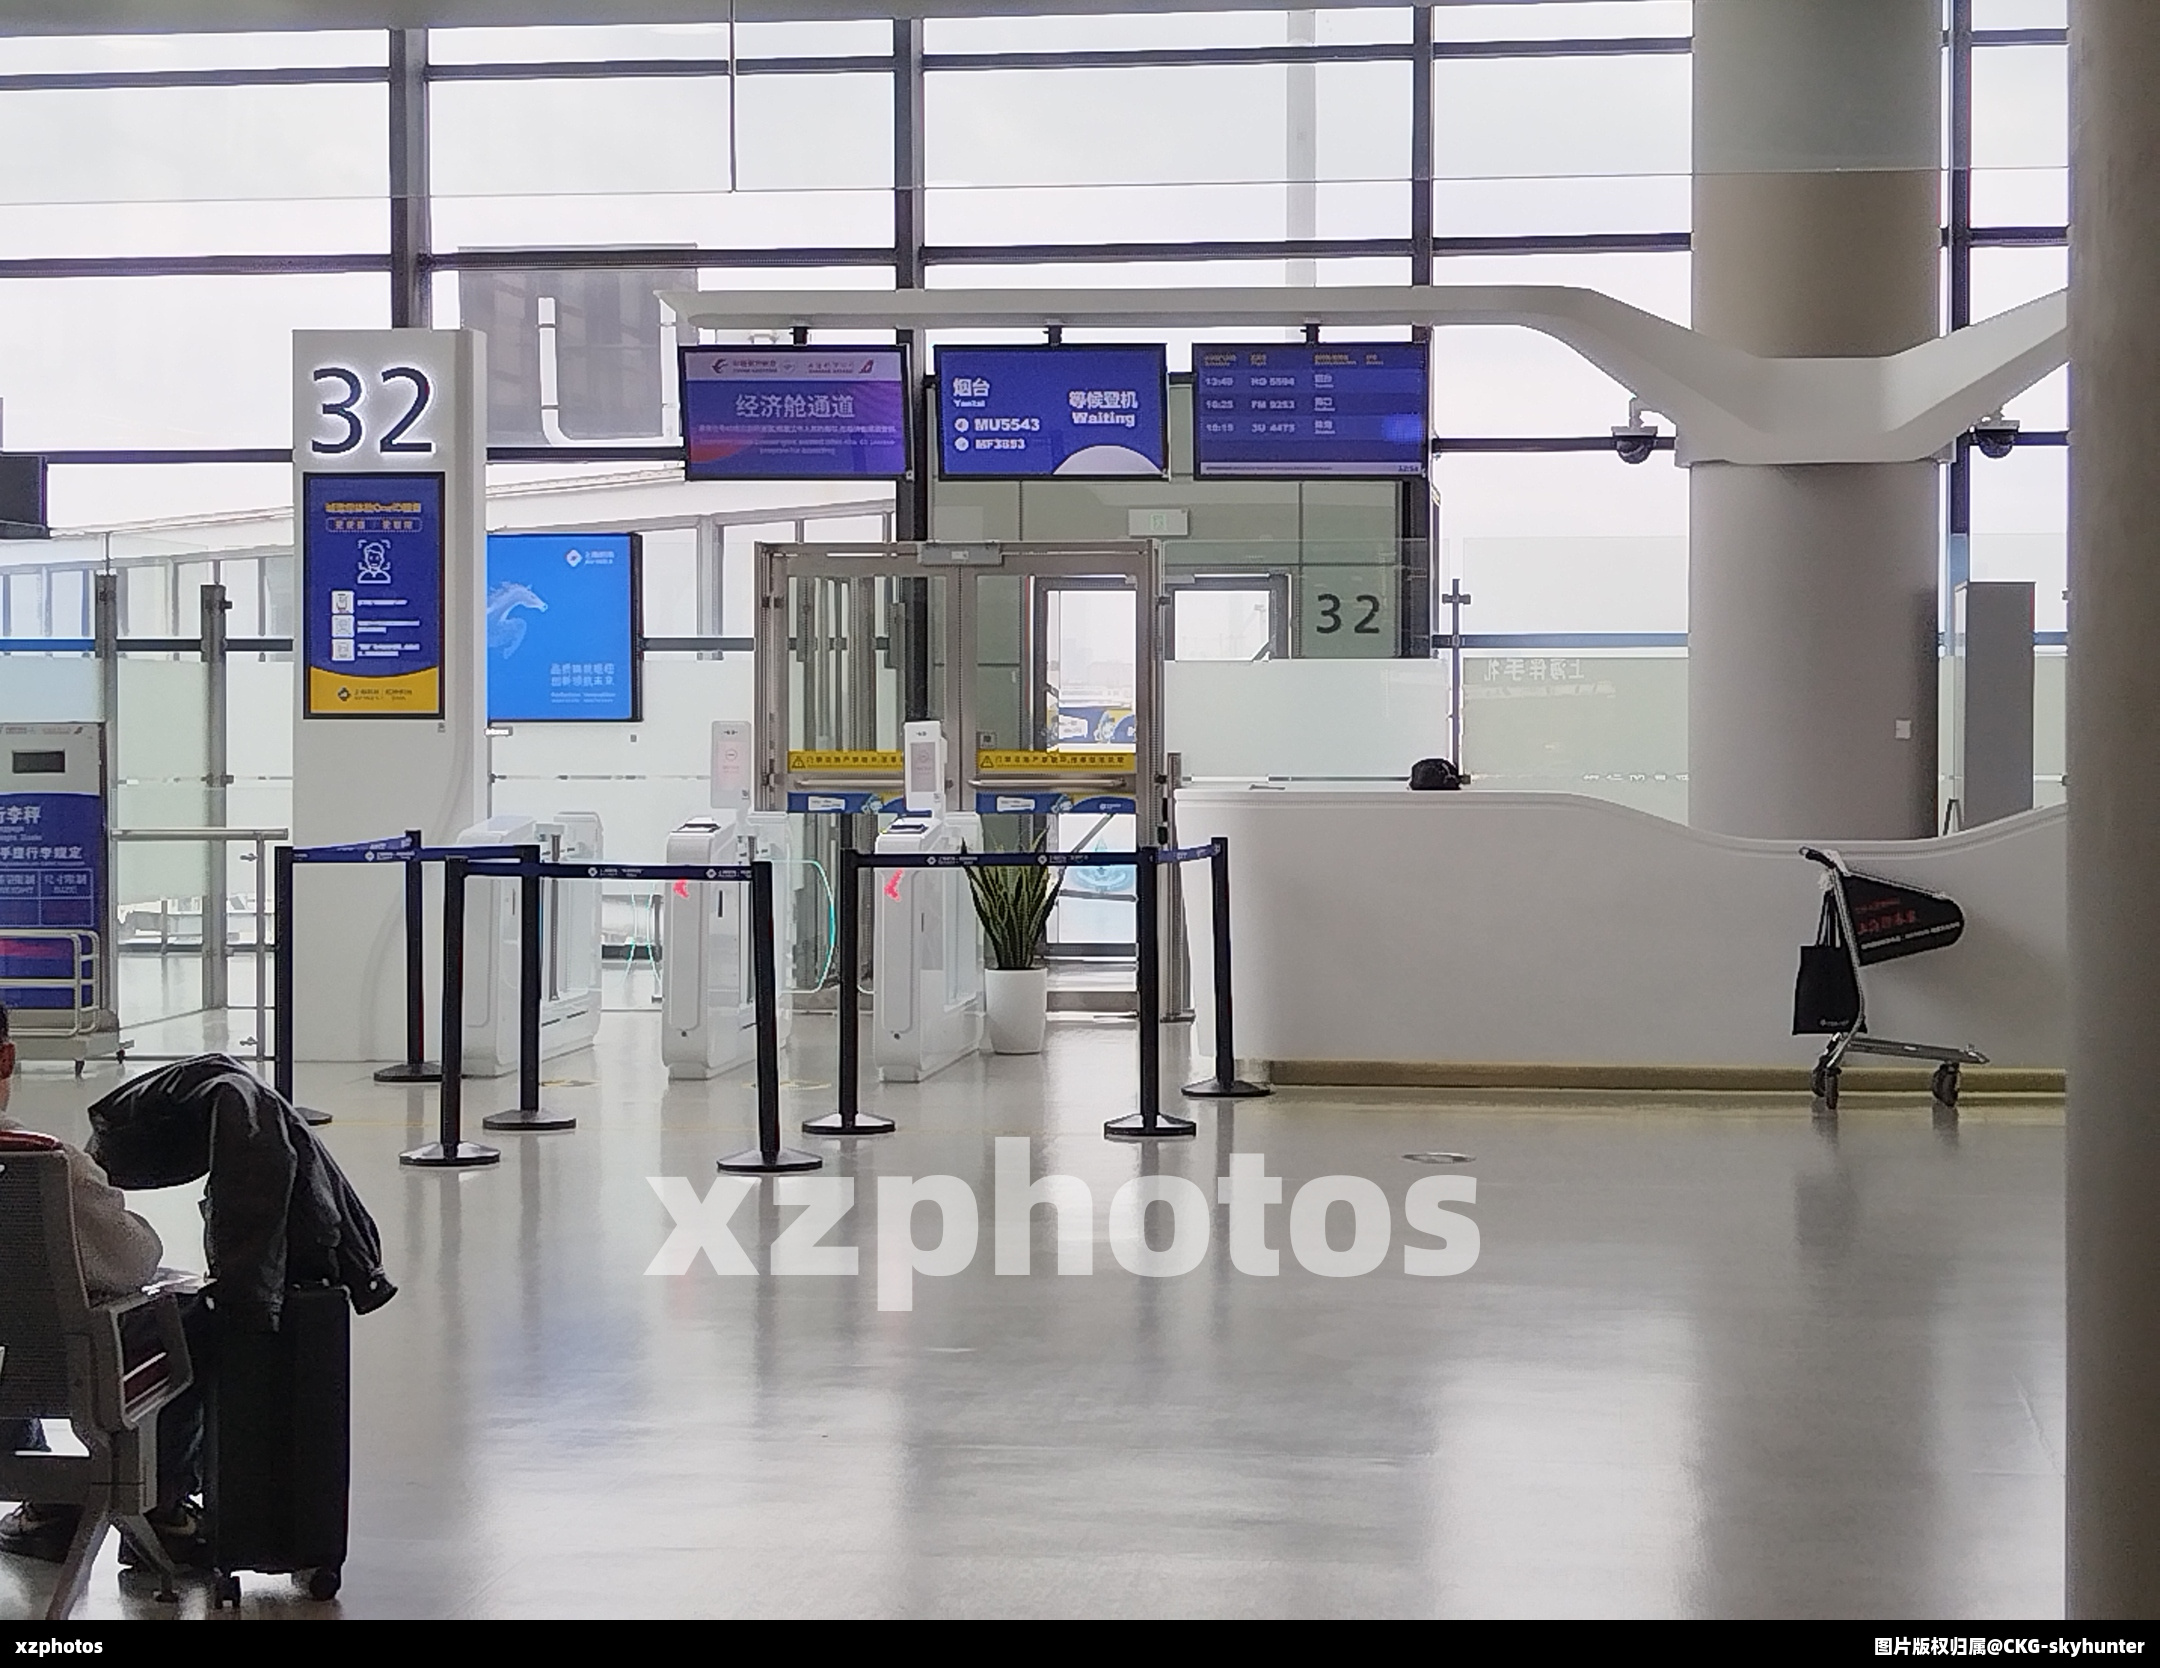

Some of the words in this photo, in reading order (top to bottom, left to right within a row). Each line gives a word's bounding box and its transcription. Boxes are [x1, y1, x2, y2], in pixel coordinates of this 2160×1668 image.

[952, 378, 990, 397] 烟台
[735, 393, 855, 418] 经济舱通道
[1068, 391, 1139, 409] 等候登机
[311, 367, 433, 454] 32
[1072, 411, 1136, 428] Waiting
[974, 418, 1041, 432] MU5543
[1315, 593, 1381, 634] 32
